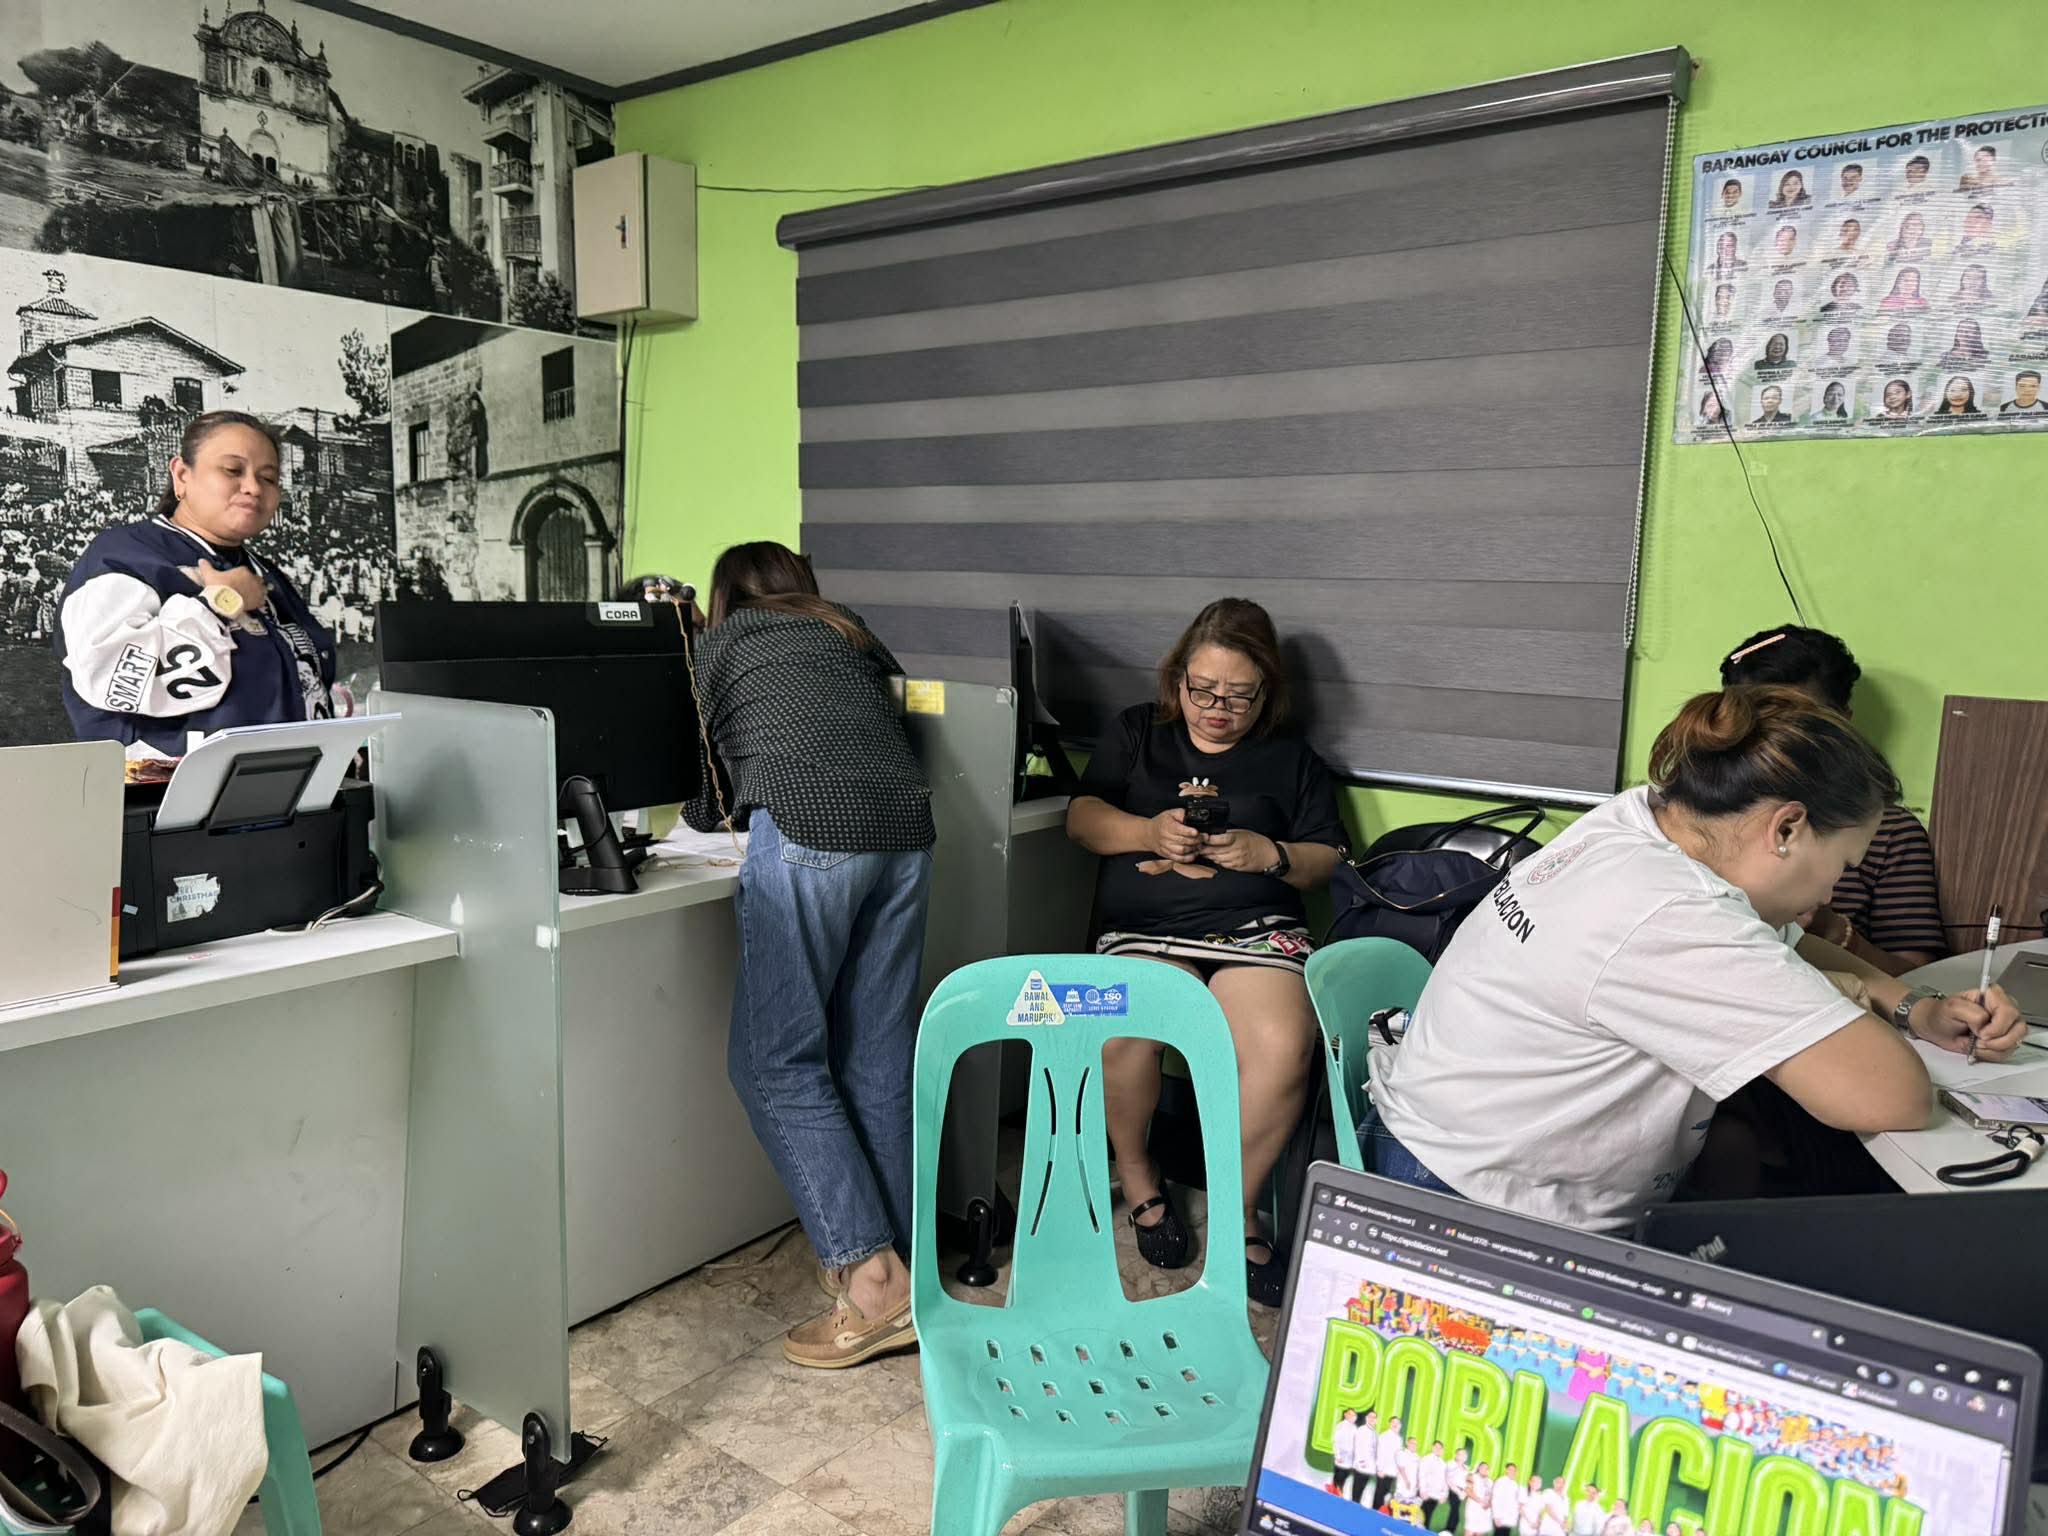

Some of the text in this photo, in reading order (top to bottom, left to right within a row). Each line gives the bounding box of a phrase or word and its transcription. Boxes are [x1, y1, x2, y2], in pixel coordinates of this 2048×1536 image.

[1702, 149, 1791, 173] BARANGAY
[1794, 138, 1872, 160] COUNCIL
[1876, 131, 1912, 150] FOR
[1917, 126, 1950, 143] THE
[606, 610, 638, 619] CORA
[155, 644, 222, 699] 25
[109, 646, 154, 712] SMART
[1024, 992, 1049, 1001] BAWAL
[1104, 992, 1121, 1001] ISO
[1030, 1002, 1045, 1011] ANG
